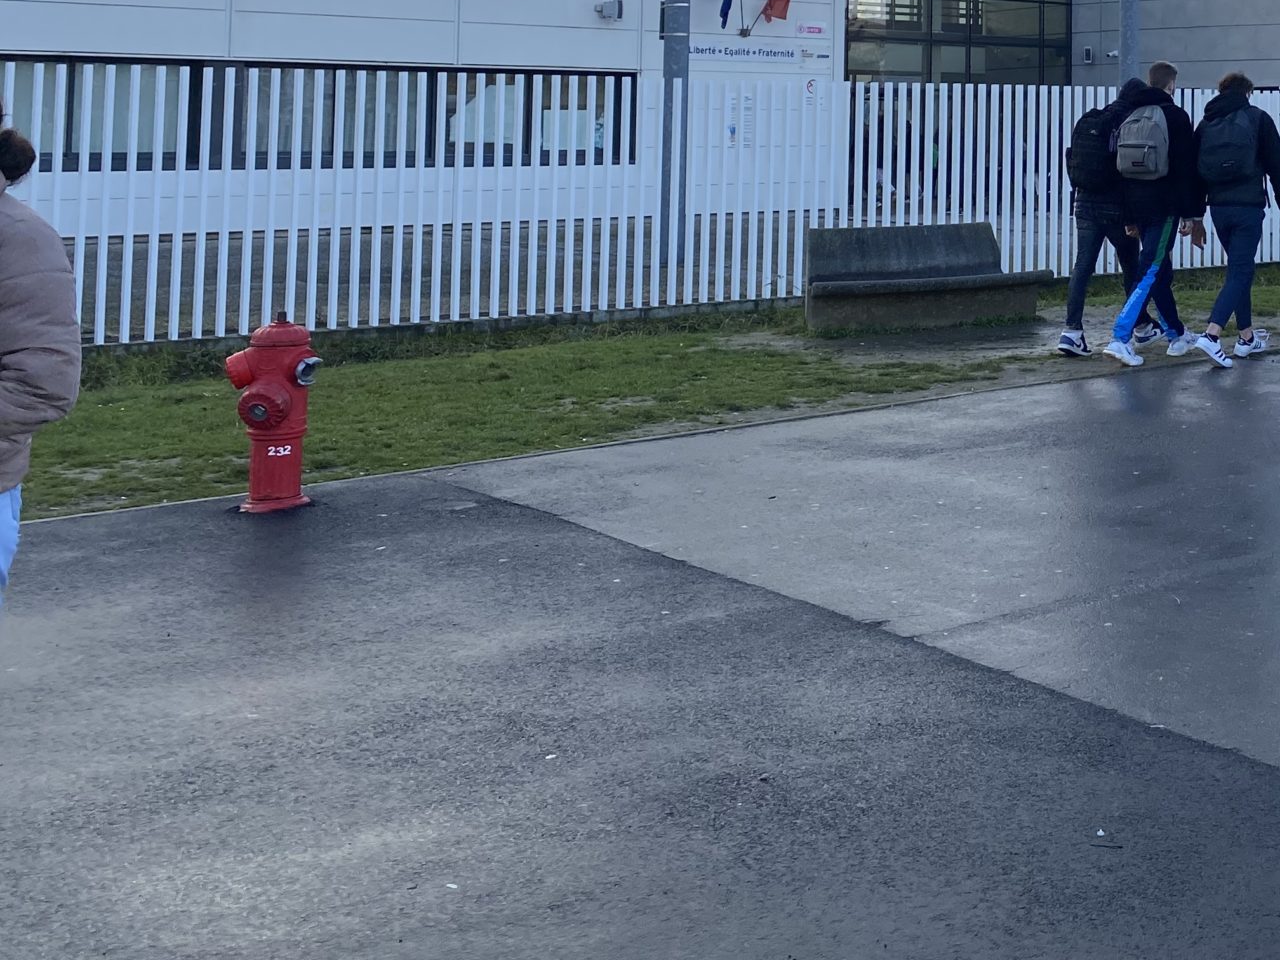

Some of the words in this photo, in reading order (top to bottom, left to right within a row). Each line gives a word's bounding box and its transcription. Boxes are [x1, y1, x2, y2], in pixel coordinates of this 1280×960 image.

[688, 46, 716, 55] Liberté
[758, 48, 795, 58] Fraternité
[267, 445, 292, 456] 232
